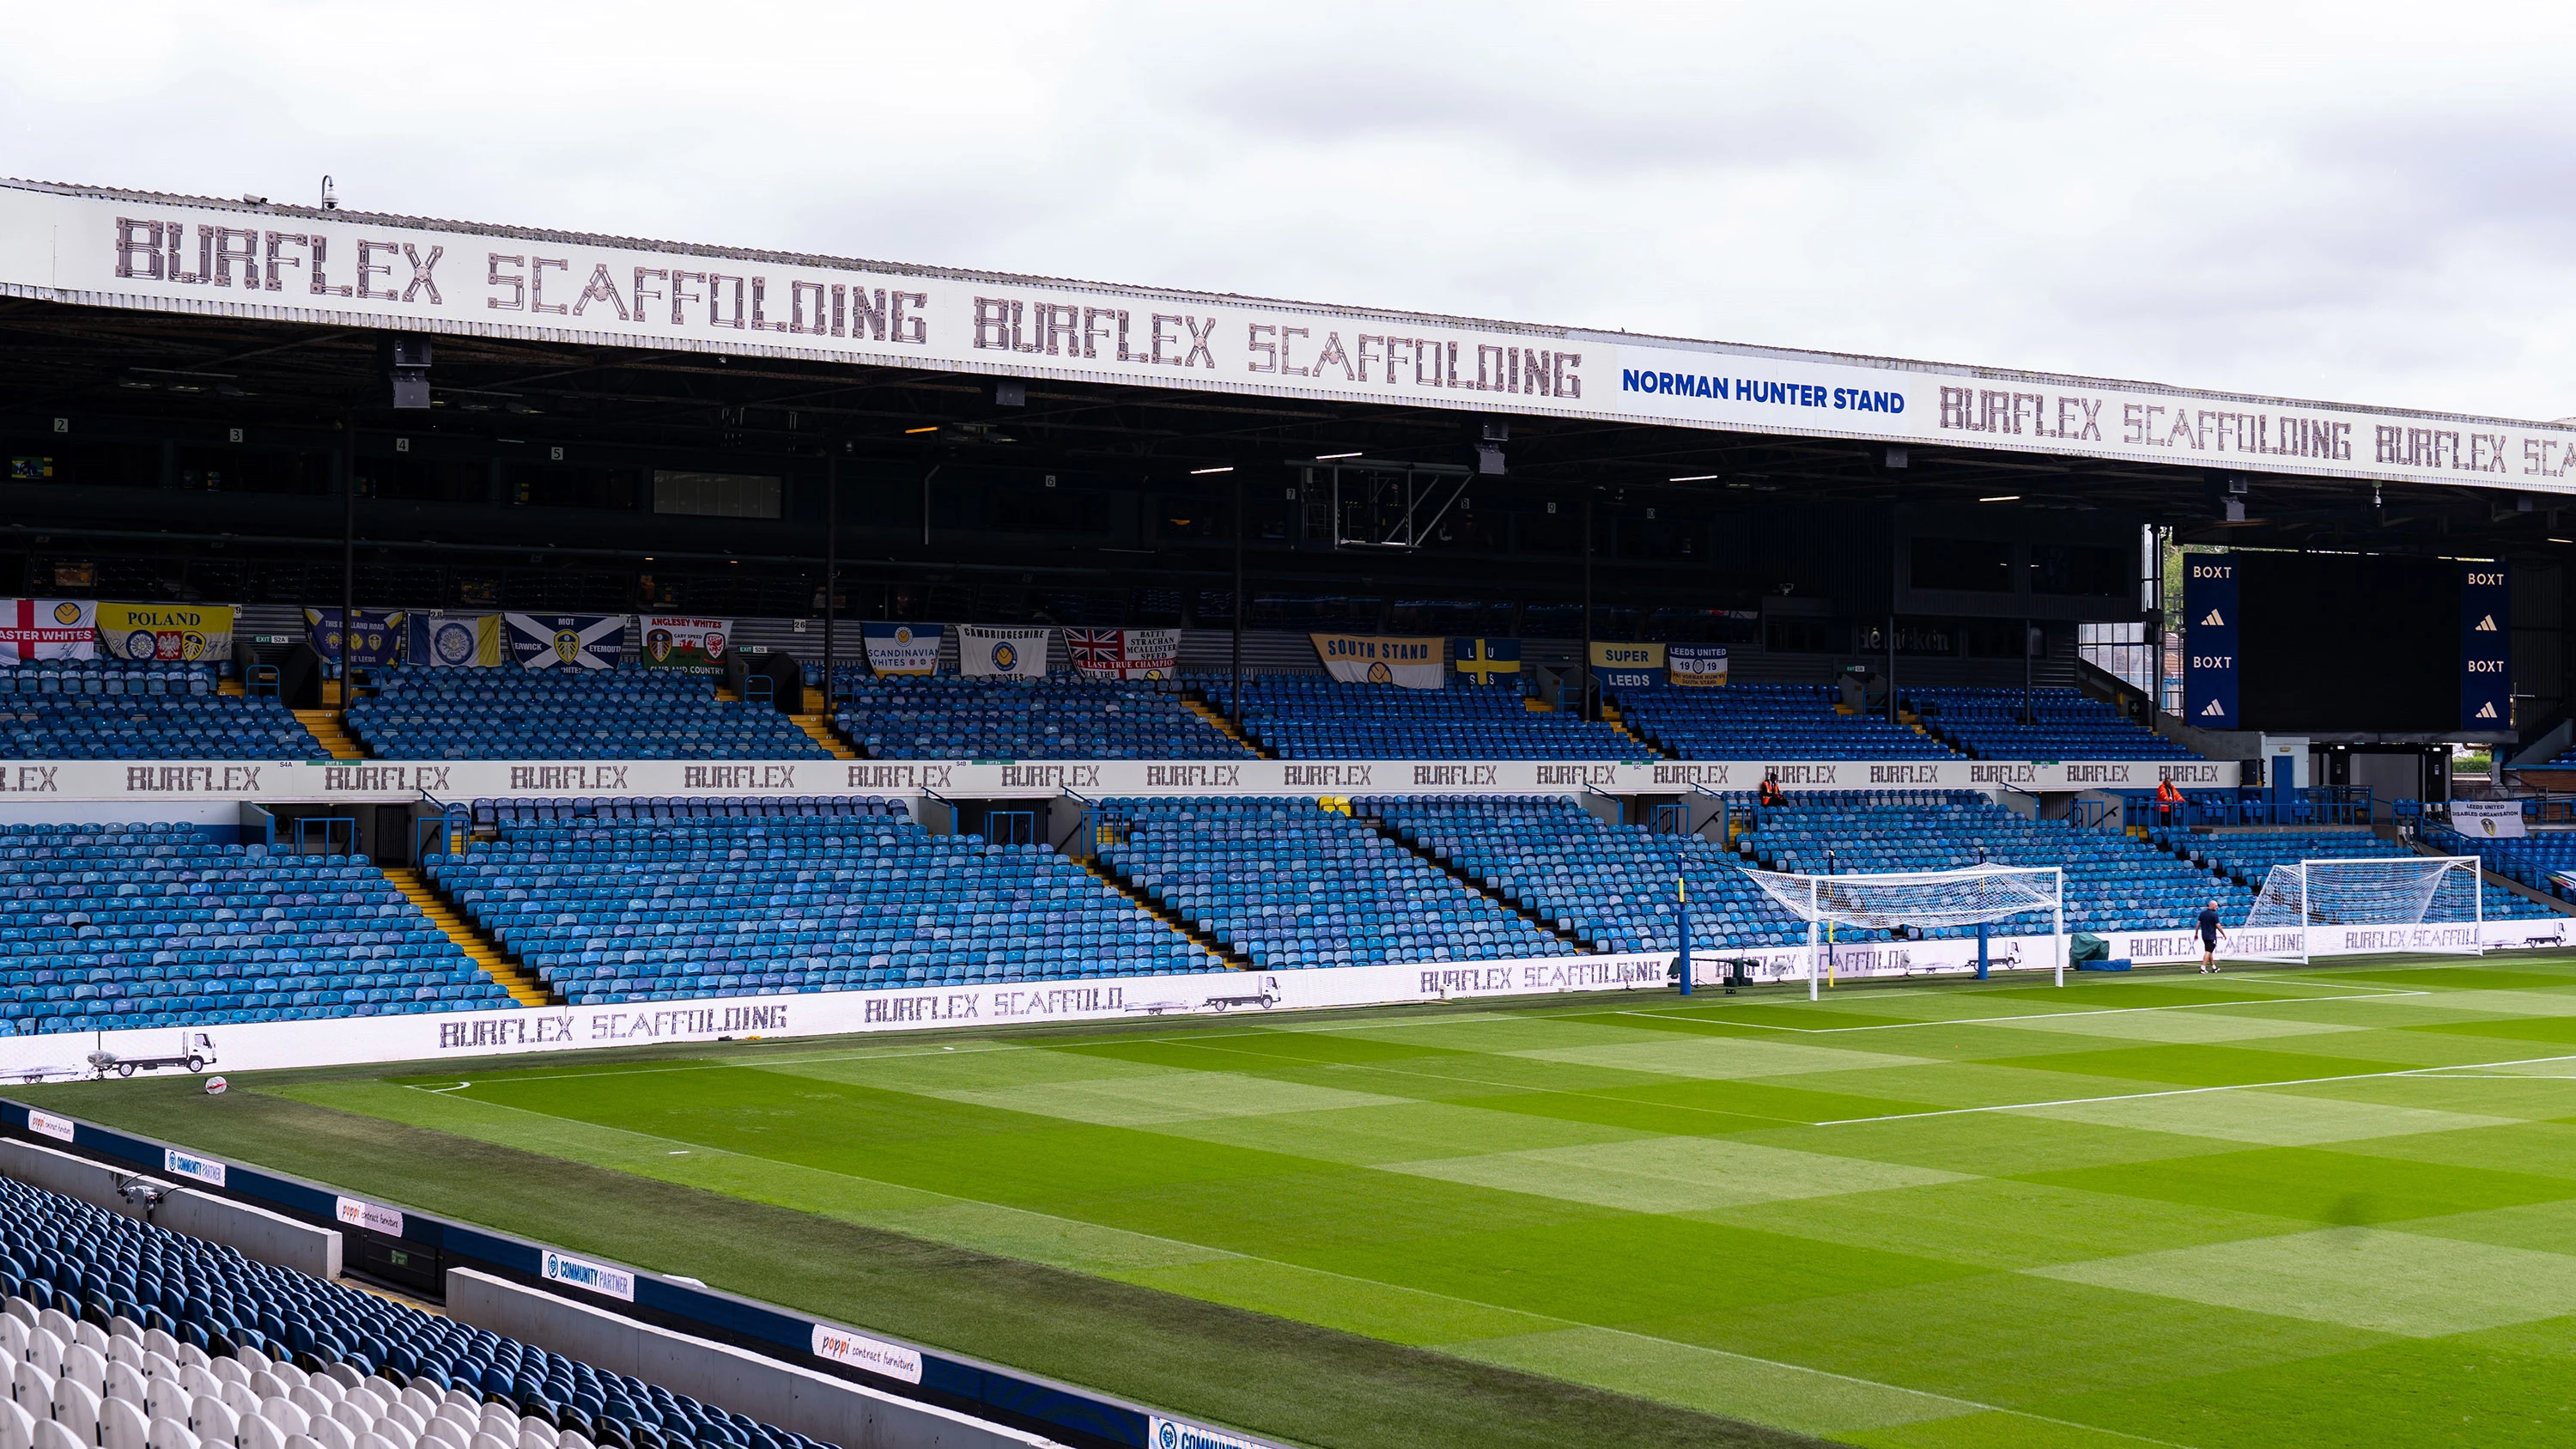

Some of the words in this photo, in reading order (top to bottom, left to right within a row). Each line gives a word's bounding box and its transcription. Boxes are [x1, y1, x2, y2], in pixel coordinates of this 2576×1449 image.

[116, 216, 443, 305] BURFLEX
[488, 253, 927, 344] SCAFFOLDING
[975, 295, 1215, 369] BURFLEX
[1249, 322, 1582, 399] SCAFFOLDING
[1623, 368, 1728, 400] NORMAN
[1736, 379, 1827, 408] HUNTER
[1833, 388, 1905, 414] STAND
[57, 419, 65, 431] 2
[1940, 386, 2101, 441] BURFLEX
[2123, 403, 2351, 460] SCAFFOLDING
[232, 429, 240, 441] 3
[398, 439, 406, 450] 4
[554, 447, 561, 459] 5
[2375, 424, 2506, 473] BURFLEX
[1047, 477, 1054, 486] 6
[1288, 490, 1294, 498] 7
[1462, 499, 1468, 508] 8
[1548, 503, 1555, 512] 9
[2193, 566, 2232, 579] BOXT
[2468, 573, 2504, 586] BOXT
[127, 612, 201, 626] POLAND
[652, 618, 690, 627] ANGLESEY
[692, 618, 722, 629] WHITES
[0, 630, 39, 641] ASTER
[42, 630, 92, 641] WHITES
[964, 628, 1044, 640] CAMBRIDGESHIRE
[1131, 636, 1175, 646] STRACHAN
[1127, 644, 1176, 654] MCALLISTER
[1327, 639, 1374, 659] SOUTH
[1382, 644, 1428, 659] STAND
[1468, 648, 1473, 658] L
[1487, 648, 1493, 658] U
[1606, 649, 1649, 662] SUPER
[1670, 647, 1694, 656] LEEDS
[690, 667, 724, 675] COUNTRY
[1111, 661, 1133, 669] TRUE
[2193, 657, 2232, 669] BOXT
[2468, 661, 2504, 673] BOXT
[989, 673, 1024, 682] WTES
[1469, 675, 1475, 685] S
[1489, 674, 1494, 685] S
[1608, 674, 1649, 686] LEEDS
[127, 766, 260, 791] BURFLEX
[325, 766, 450, 791] BURFLEX
[511, 766, 628, 789] BURFLEX
[684, 765, 795, 788] BURFLEX
[848, 765, 951, 788] BURFLEX
[1002, 765, 1100, 787] BURFLEX
[1147, 765, 1239, 786] BURFLEX
[1285, 765, 1371, 786] BURFLEX
[1413, 765, 1497, 785] BURFLEX
[1537, 765, 1616, 784] BURFLEX
[1654, 765, 1728, 784] BURFLEX
[1870, 765, 1938, 783] BURFLEX
[1971, 765, 2036, 782] BURFLEX
[2067, 765, 2129, 782] BURFLEX
[2129, 936, 2196, 958] BURFLEX
[2215, 934, 2303, 954] CAFFOLDING
[2345, 929, 2406, 949] BURFLEX
[1524, 961, 1661, 988] SCAFFOLDNG
[865, 993, 979, 1023] BURFLEX
[440, 1015, 574, 1049] BURFLEX
[592, 1005, 787, 1039] SCAFFOLDING
[177, 1156, 202, 1177] COMMUNITY
[342, 1205, 361, 1222] poppi
[561, 1260, 598, 1287] COMMUNITY
[598, 1271, 628, 1295] PARTNER
[822, 1336, 851, 1359] poppi
[852, 1346, 881, 1363] contract
[884, 1351, 914, 1372] furniture
